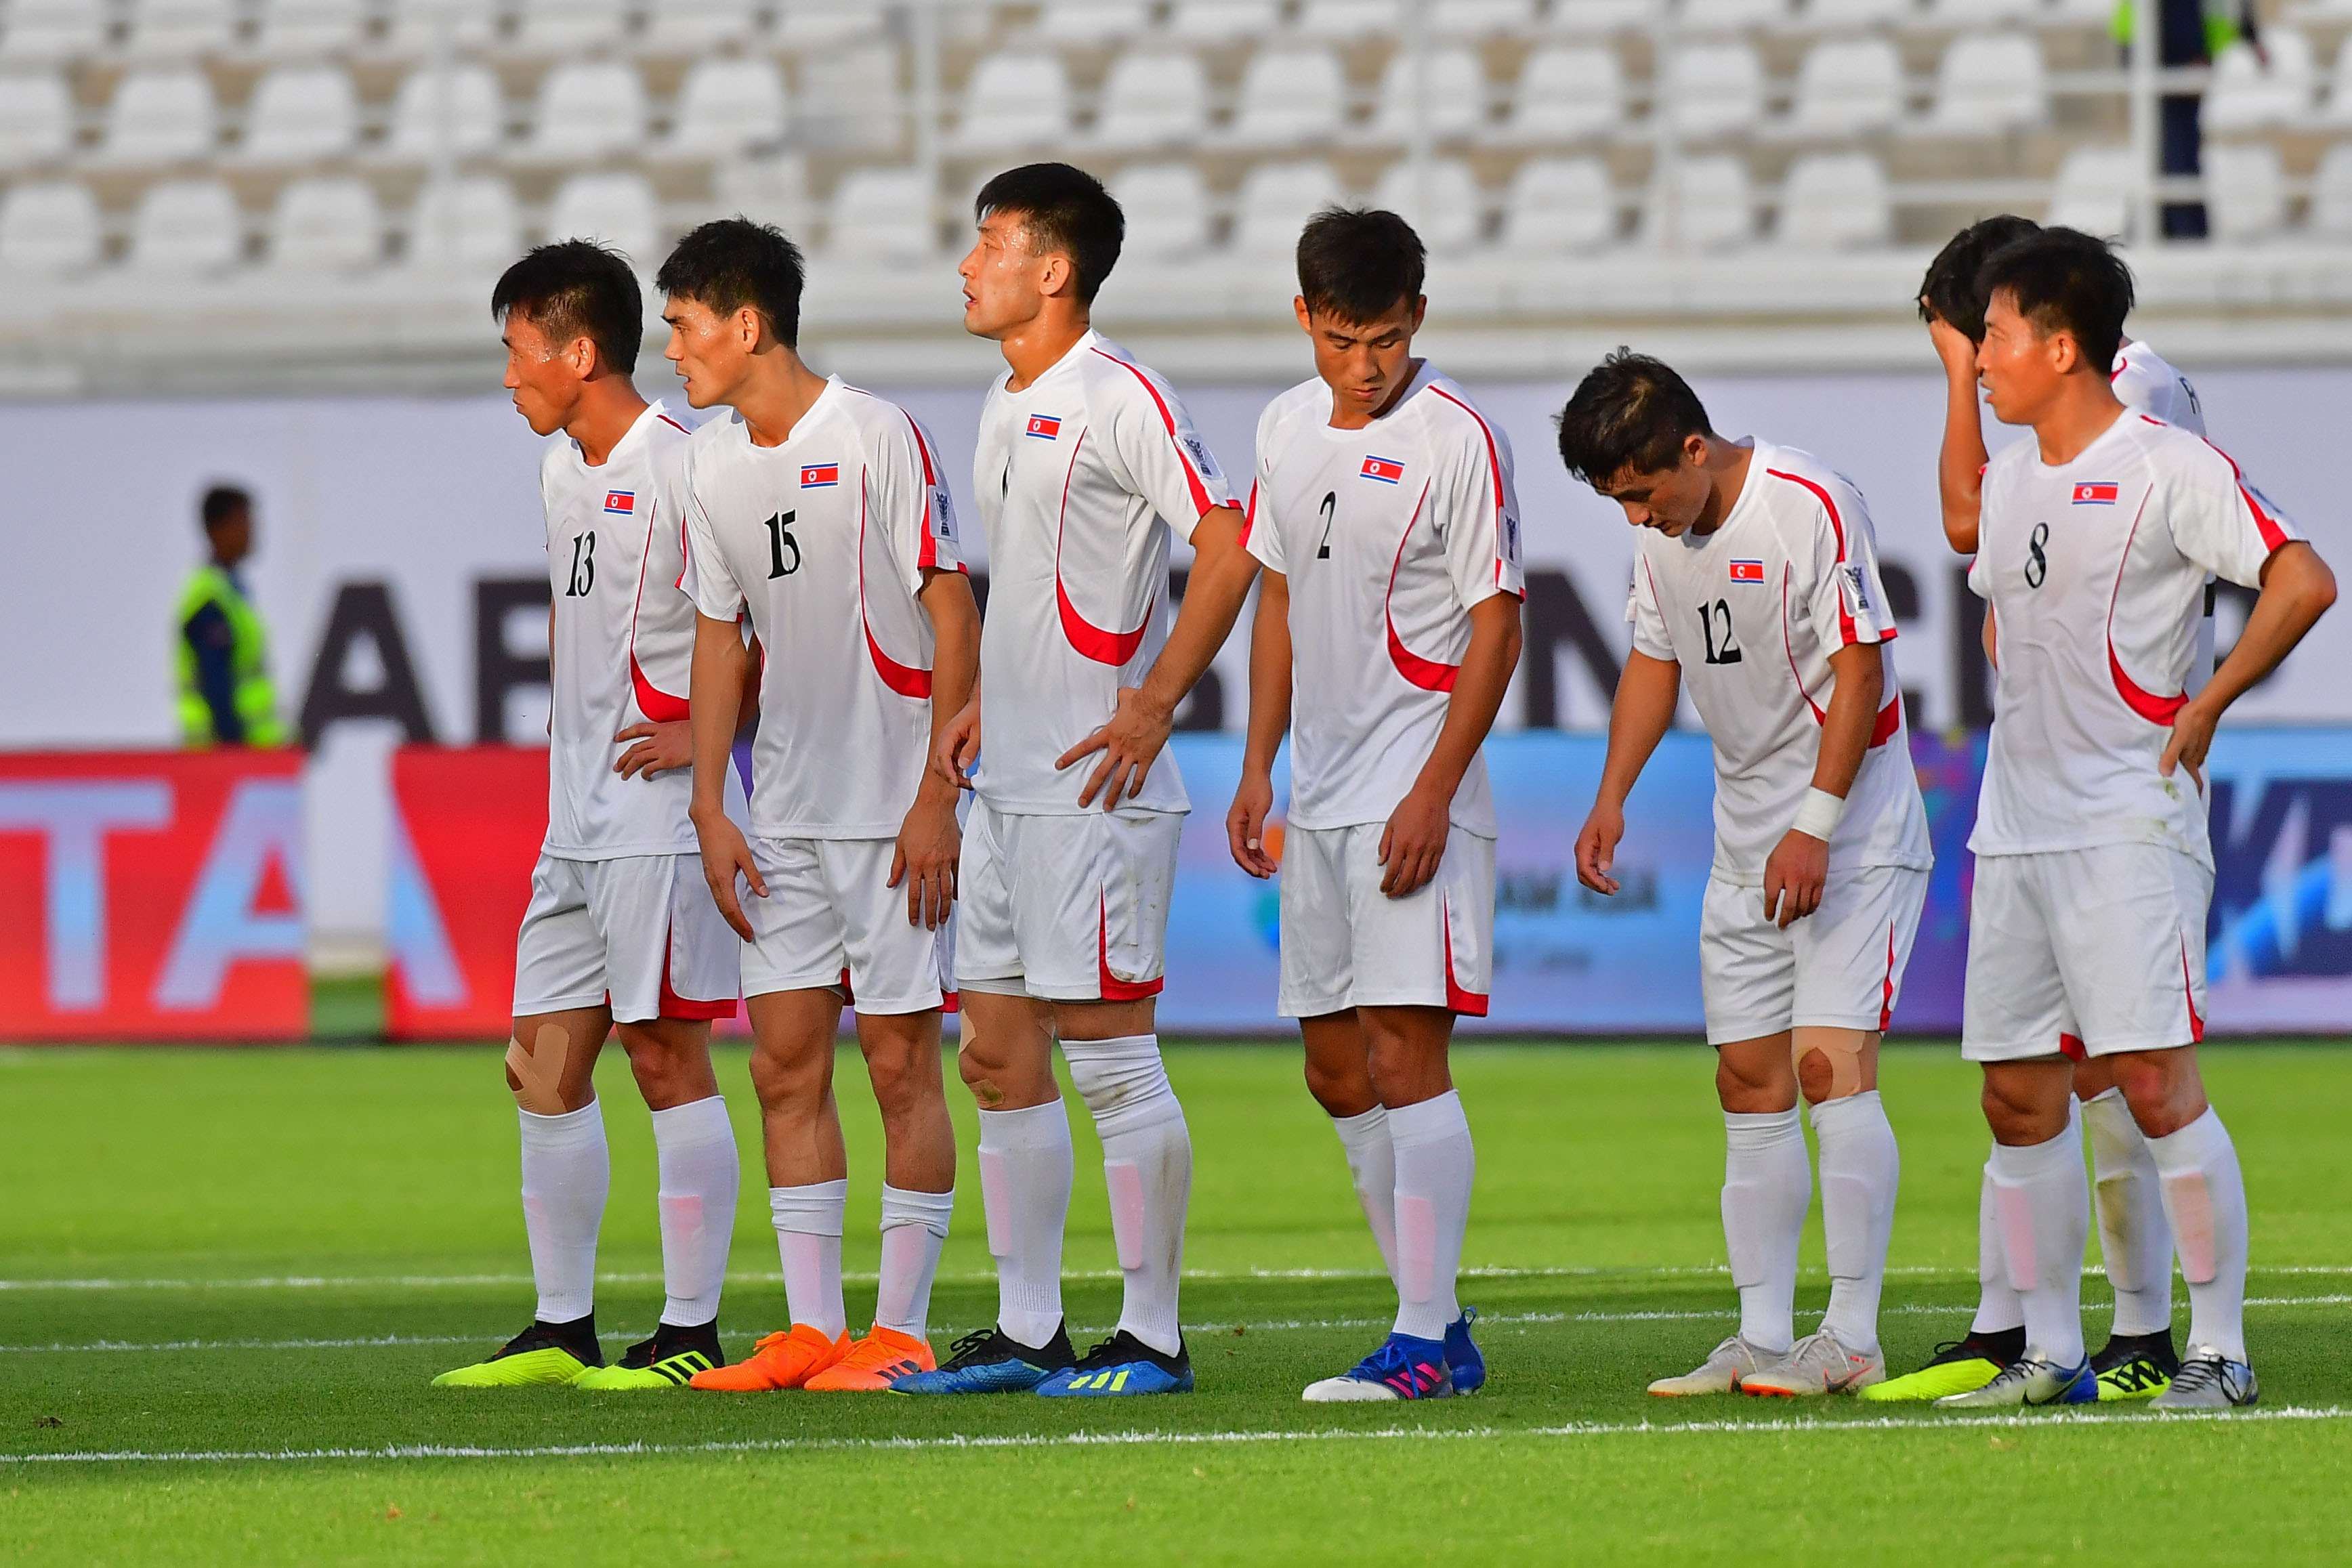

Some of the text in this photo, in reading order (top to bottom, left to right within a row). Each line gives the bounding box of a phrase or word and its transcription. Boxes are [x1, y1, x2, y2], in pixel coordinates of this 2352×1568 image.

[764, 509, 801, 580] 15
[1317, 491, 1337, 560] 2
[2024, 522, 2049, 589] 8
[566, 530, 596, 598] 13
[1697, 598, 1742, 665] 12
